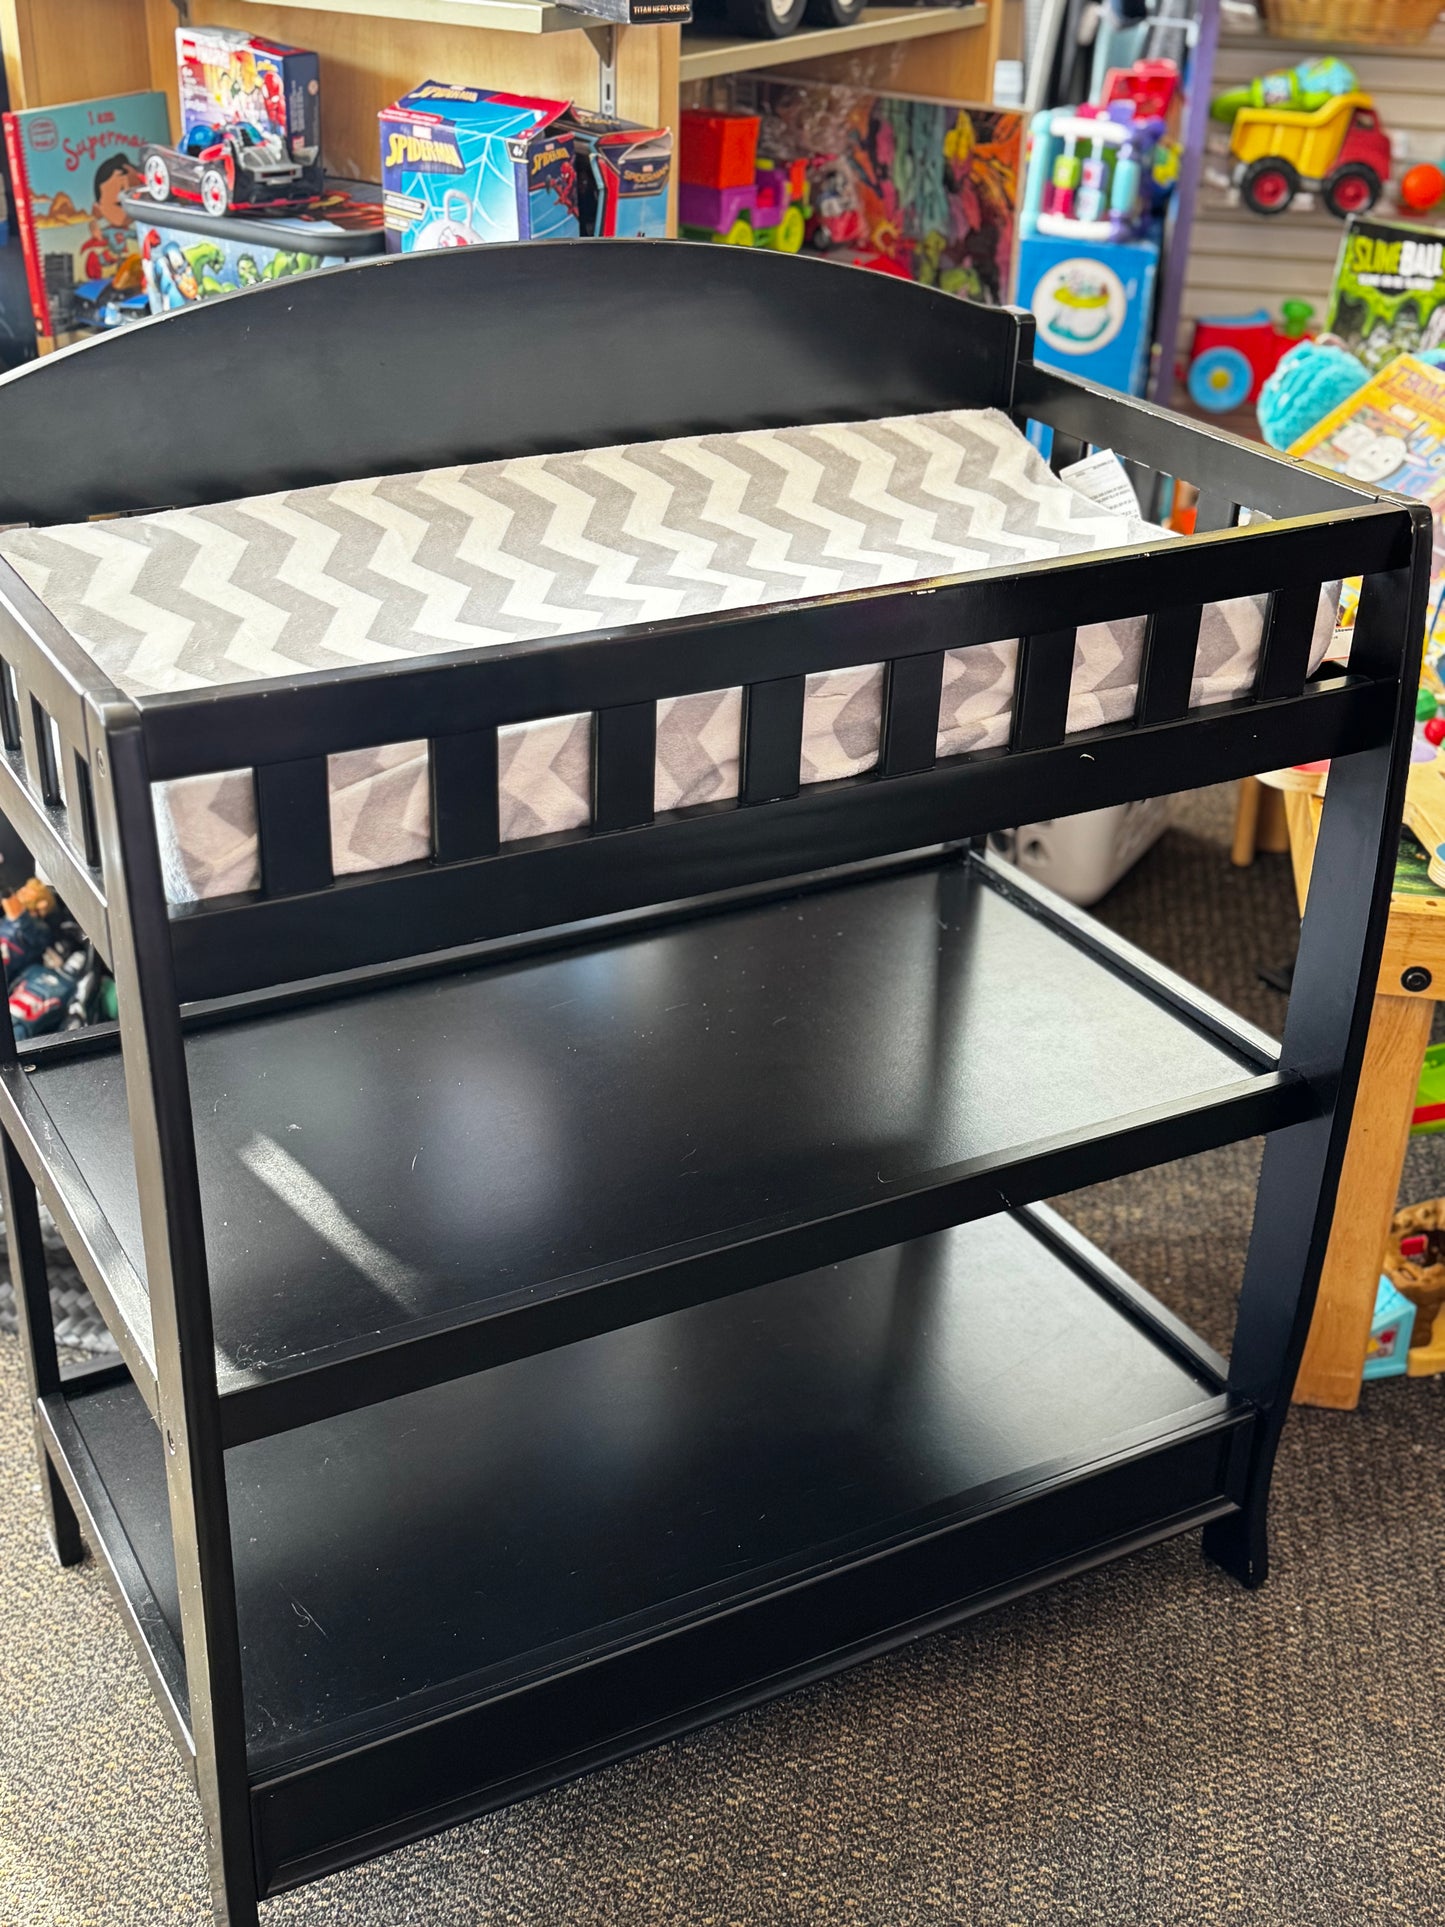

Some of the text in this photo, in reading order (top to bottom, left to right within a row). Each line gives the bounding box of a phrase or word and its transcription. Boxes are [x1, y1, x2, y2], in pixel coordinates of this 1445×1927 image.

[633, 3, 690, 15] TITAN HERO SERIES
[87, 111, 115, 126] I am
